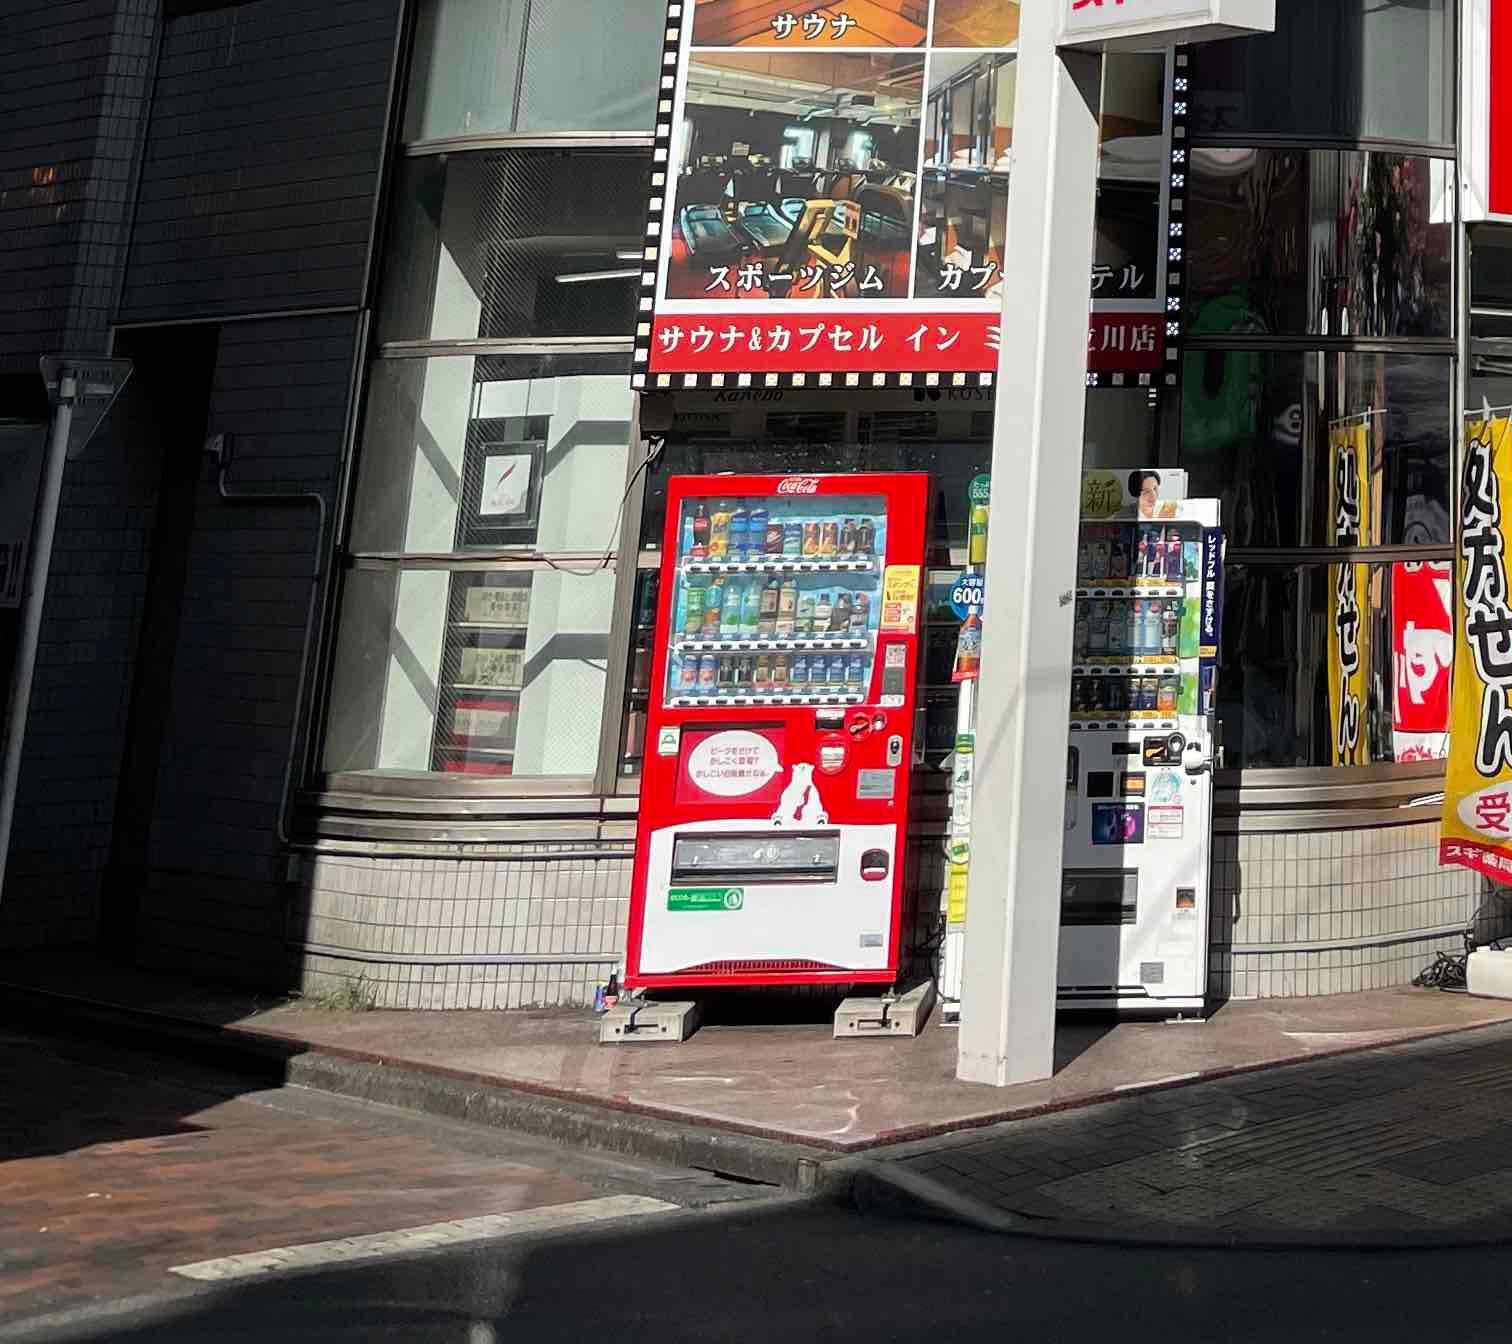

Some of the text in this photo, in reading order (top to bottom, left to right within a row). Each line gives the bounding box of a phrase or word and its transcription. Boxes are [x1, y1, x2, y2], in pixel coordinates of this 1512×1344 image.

[771, 13, 856, 40] サウナ
[705, 263, 885, 293] スポーツジム
[658, 324, 884, 354] サウナ&カプセル
[905, 325, 962, 353] イン
[1089, 325, 1156, 353] 川店
[1085, 477, 1117, 513] 新
